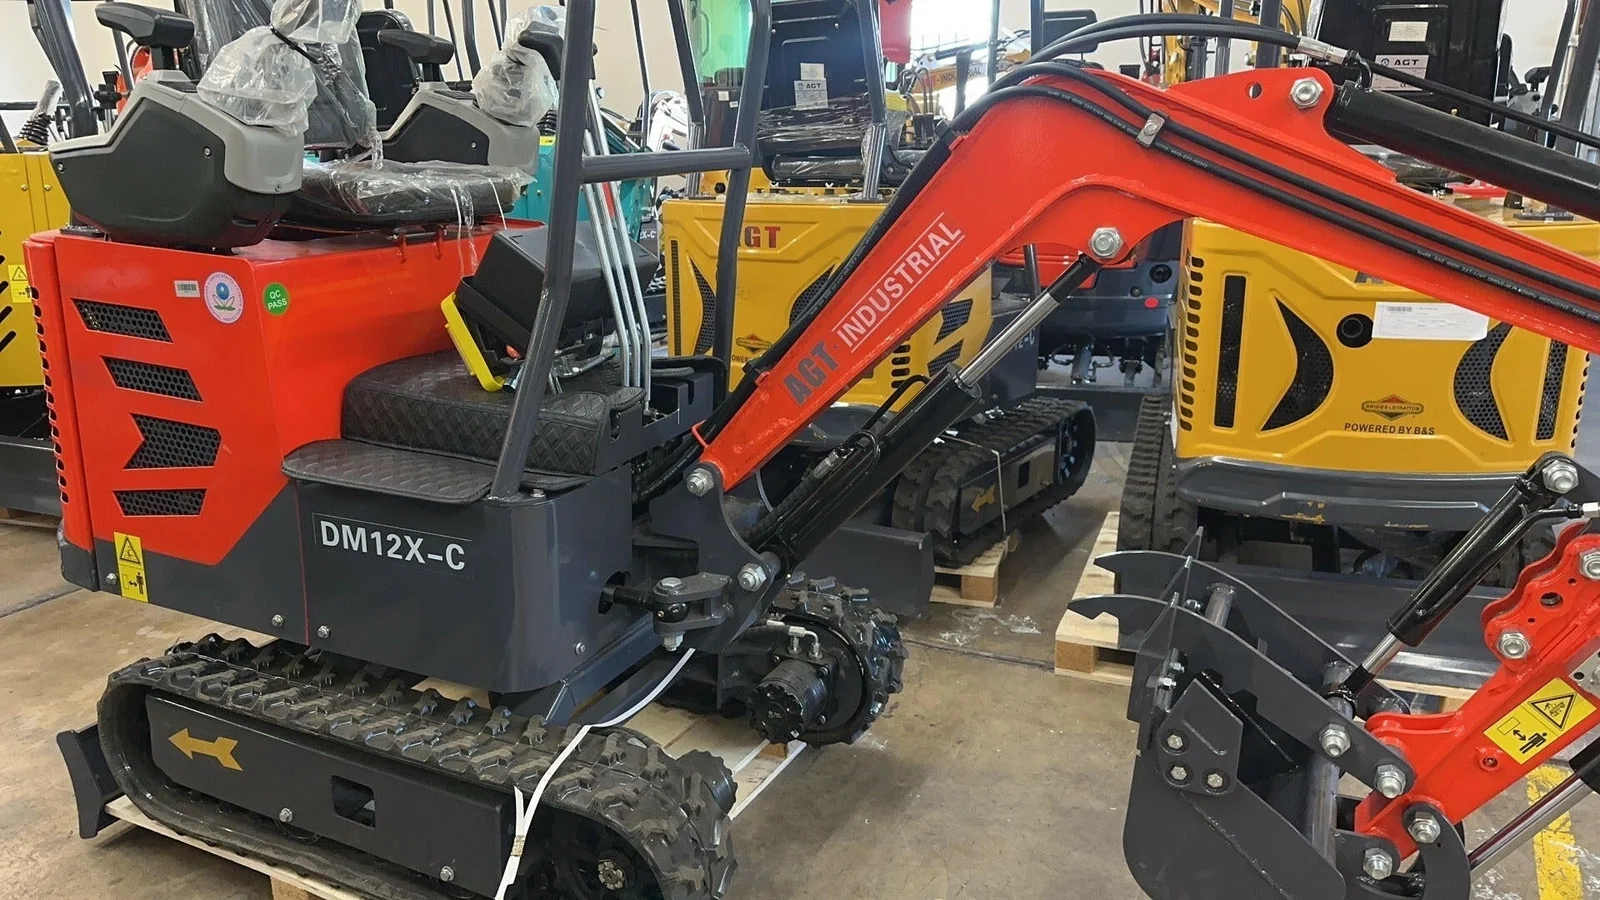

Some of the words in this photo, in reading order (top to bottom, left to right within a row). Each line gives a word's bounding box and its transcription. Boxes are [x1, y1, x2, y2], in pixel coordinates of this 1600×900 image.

[744, 226, 781, 248] GT
[269, 290, 281, 299] QC
[837, 222, 962, 348] INDUSTRIAL
[267, 298, 288, 310] PASS
[783, 340, 838, 405] AGT
[1344, 423, 1396, 434] POWERED
[1398, 426, 1412, 434] BY
[1414, 427, 1435, 435] B&S
[320, 520, 466, 571] DM12X-C
